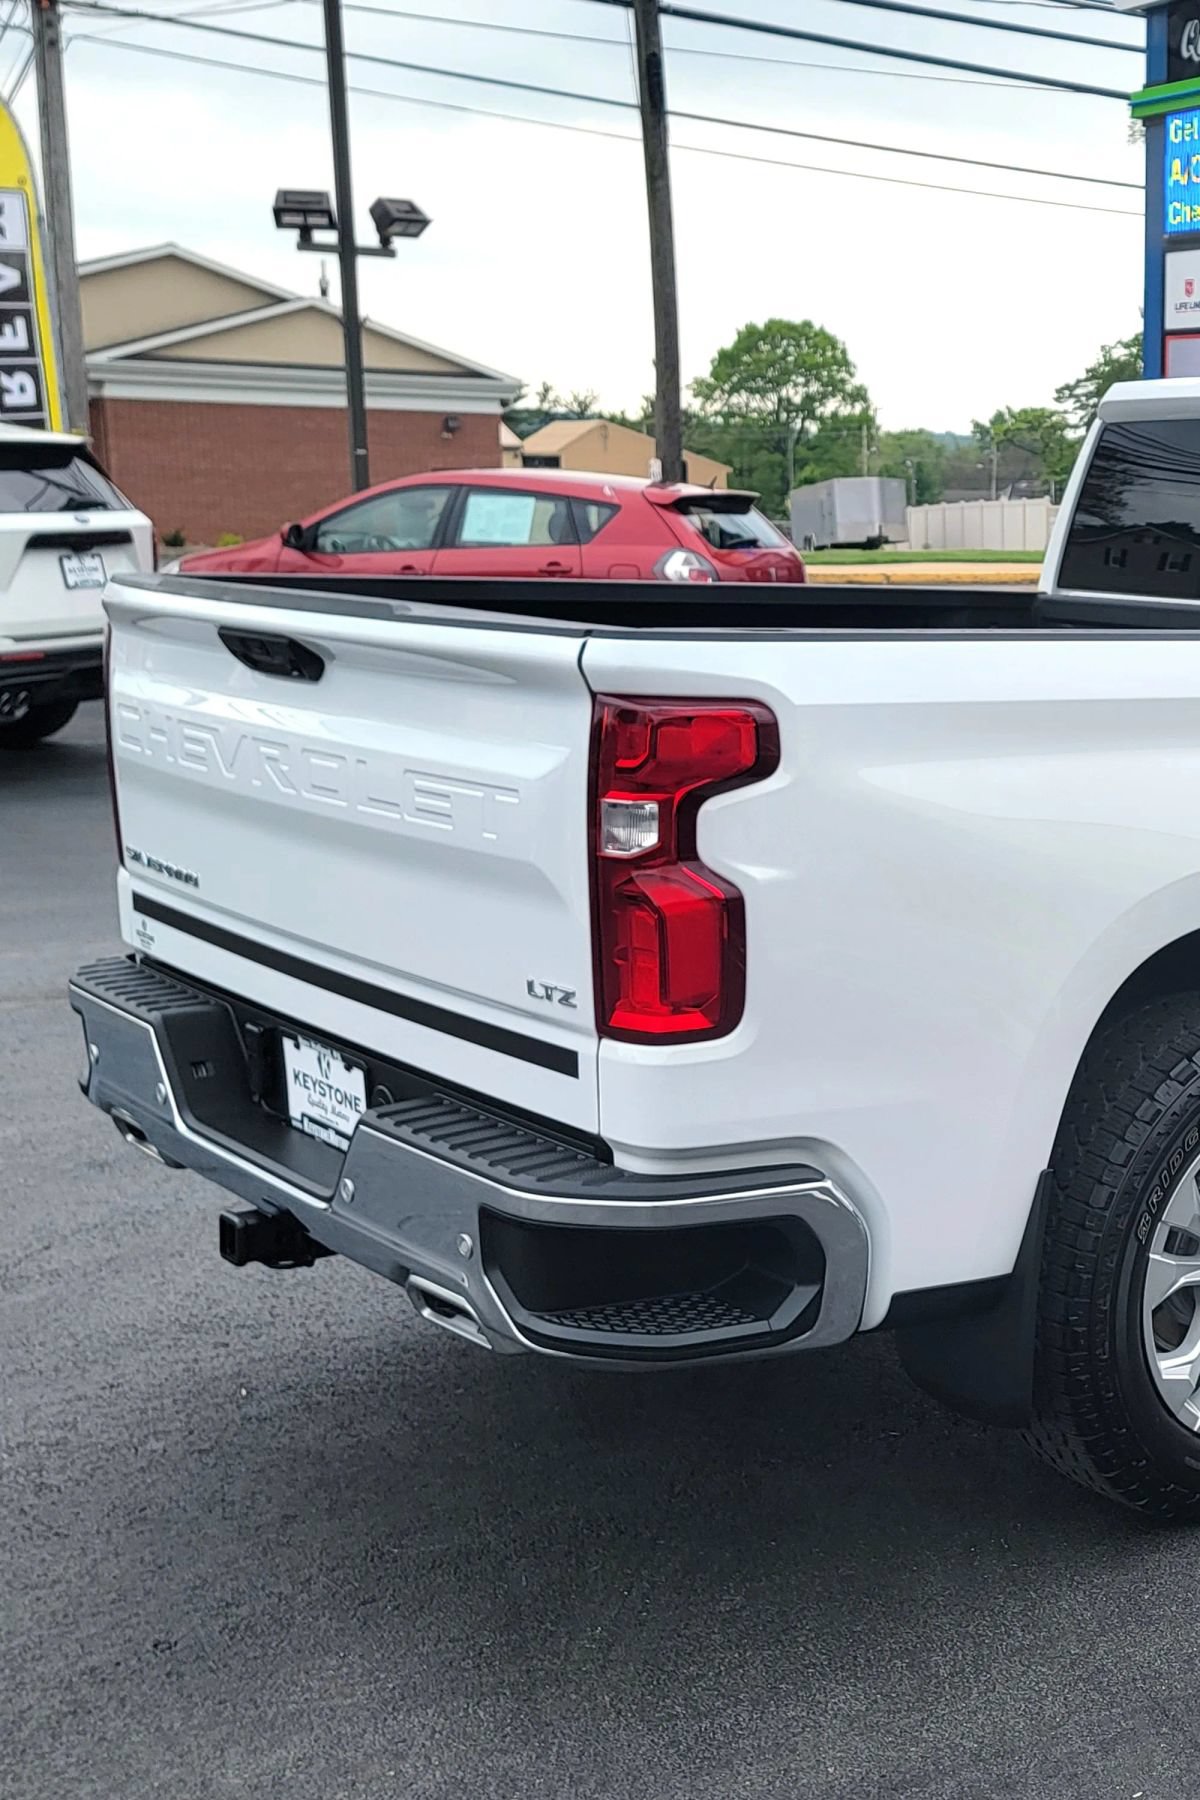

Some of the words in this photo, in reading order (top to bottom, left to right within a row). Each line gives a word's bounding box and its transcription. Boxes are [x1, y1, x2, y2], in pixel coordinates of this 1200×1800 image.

[115, 701, 520, 840] CHEVROLET
[526, 978, 577, 1009] LTZ
[292, 1067, 363, 1115] KEYSTONE
